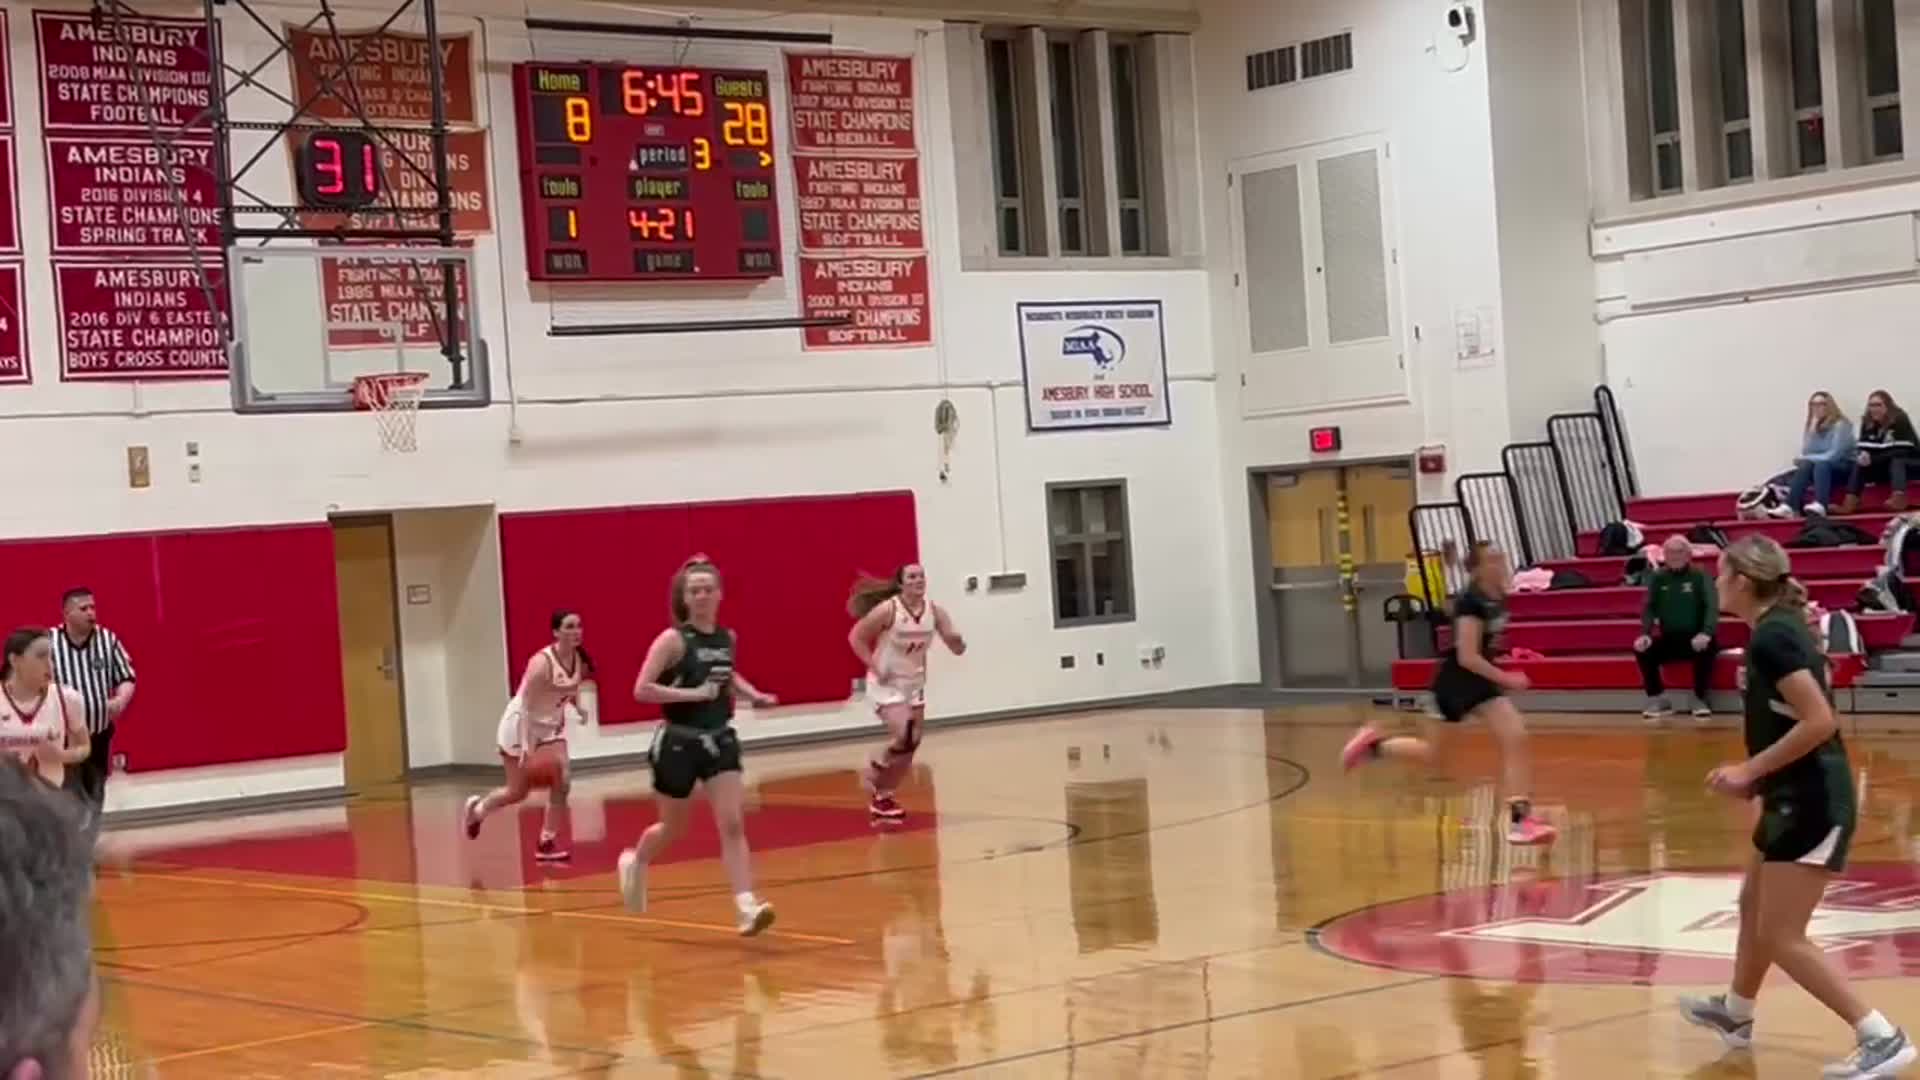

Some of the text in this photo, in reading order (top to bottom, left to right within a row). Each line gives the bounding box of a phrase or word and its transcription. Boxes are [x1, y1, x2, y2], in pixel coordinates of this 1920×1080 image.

[93, 45, 177, 66] INDANS
[801, 58, 898, 79] AMESBURY
[538, 69, 580, 91] Home
[714, 77, 762, 97] Guests
[58, 82, 112, 102] STATE
[622, 70, 704, 116] 6:45
[343, 104, 430, 119] FOTBALL
[565, 97, 591, 142] 8
[795, 111, 912, 131] STATE CHAMPIONS
[723, 102, 769, 146] 28
[815, 131, 895, 146] BASEBALL
[400, 152, 470, 171] INDINS
[639, 137, 711, 169] period 3
[95, 166, 186, 183] INDIANS
[313, 138, 377, 194] 31
[807, 160, 905, 180] AMESBURY
[81, 188, 203, 204] 2016 DIVISIN 4
[377, 193, 482, 211] CHAMPONS
[61, 206, 117, 224] STATE
[567, 208, 577, 238] 1
[802, 211, 920, 231] STATE CHAMPIONS
[80, 227, 146, 243] SPRING
[821, 232, 904, 246] SOFTBALL
[94, 270, 201, 288] AMESBURY
[814, 260, 913, 279] AMESBURY
[114, 291, 187, 308] INDIANS
[70, 311, 229, 327] 2016 DIV 6 EASTEN
[330, 302, 465, 322] STATE CHAMPIN
[855, 308, 921, 328] CHAMPIONS
[68, 330, 124, 349] STATE
[828, 328, 908, 343] SOFTBALL
[69, 351, 109, 369] BOYS
[115, 350, 164, 367] CROSS
[1042, 383, 1154, 401] AMESBURY HIGH SCHOOL
